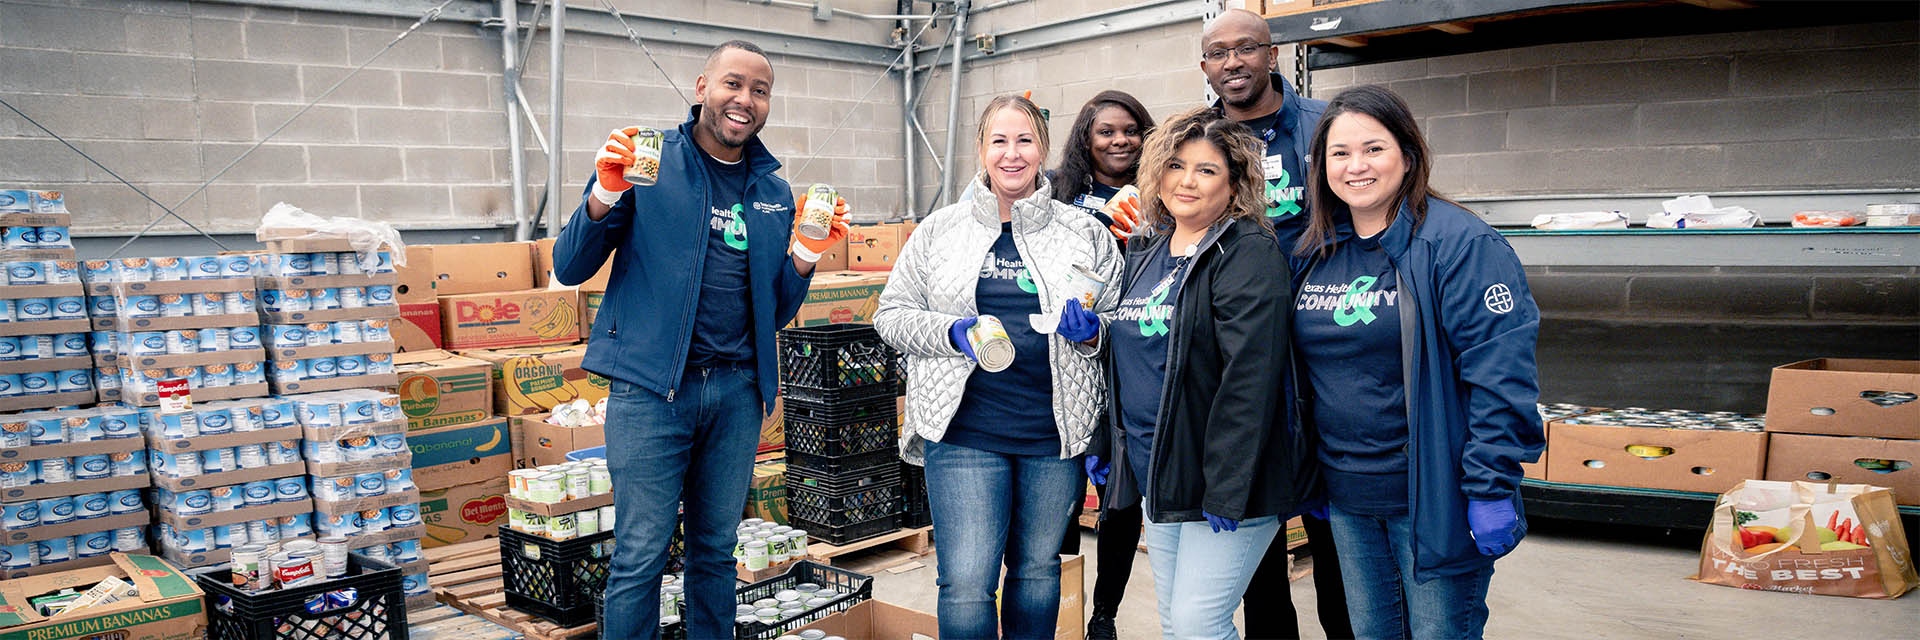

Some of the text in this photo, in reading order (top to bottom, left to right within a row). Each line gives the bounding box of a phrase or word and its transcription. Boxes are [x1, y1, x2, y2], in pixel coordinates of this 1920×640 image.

[996, 257, 1024, 268] Healt
[809, 287, 869, 300] PREMIUM BANANAS
[1297, 289, 1397, 311] COMMUNITY
[456, 298, 520, 323] Dole
[1112, 304, 1175, 321] COMMUNIT
[515, 364, 563, 379] ORGANIC
[424, 414, 476, 427] Bananas
[464, 506, 479, 517] Del
[480, 502, 506, 514] Monte
[1711, 557, 1865, 581] THE BEST
[1777, 556, 1865, 570] FRESH
[1768, 584, 1814, 595] Market
[27, 606, 171, 640] PREMIUM BANANAS
